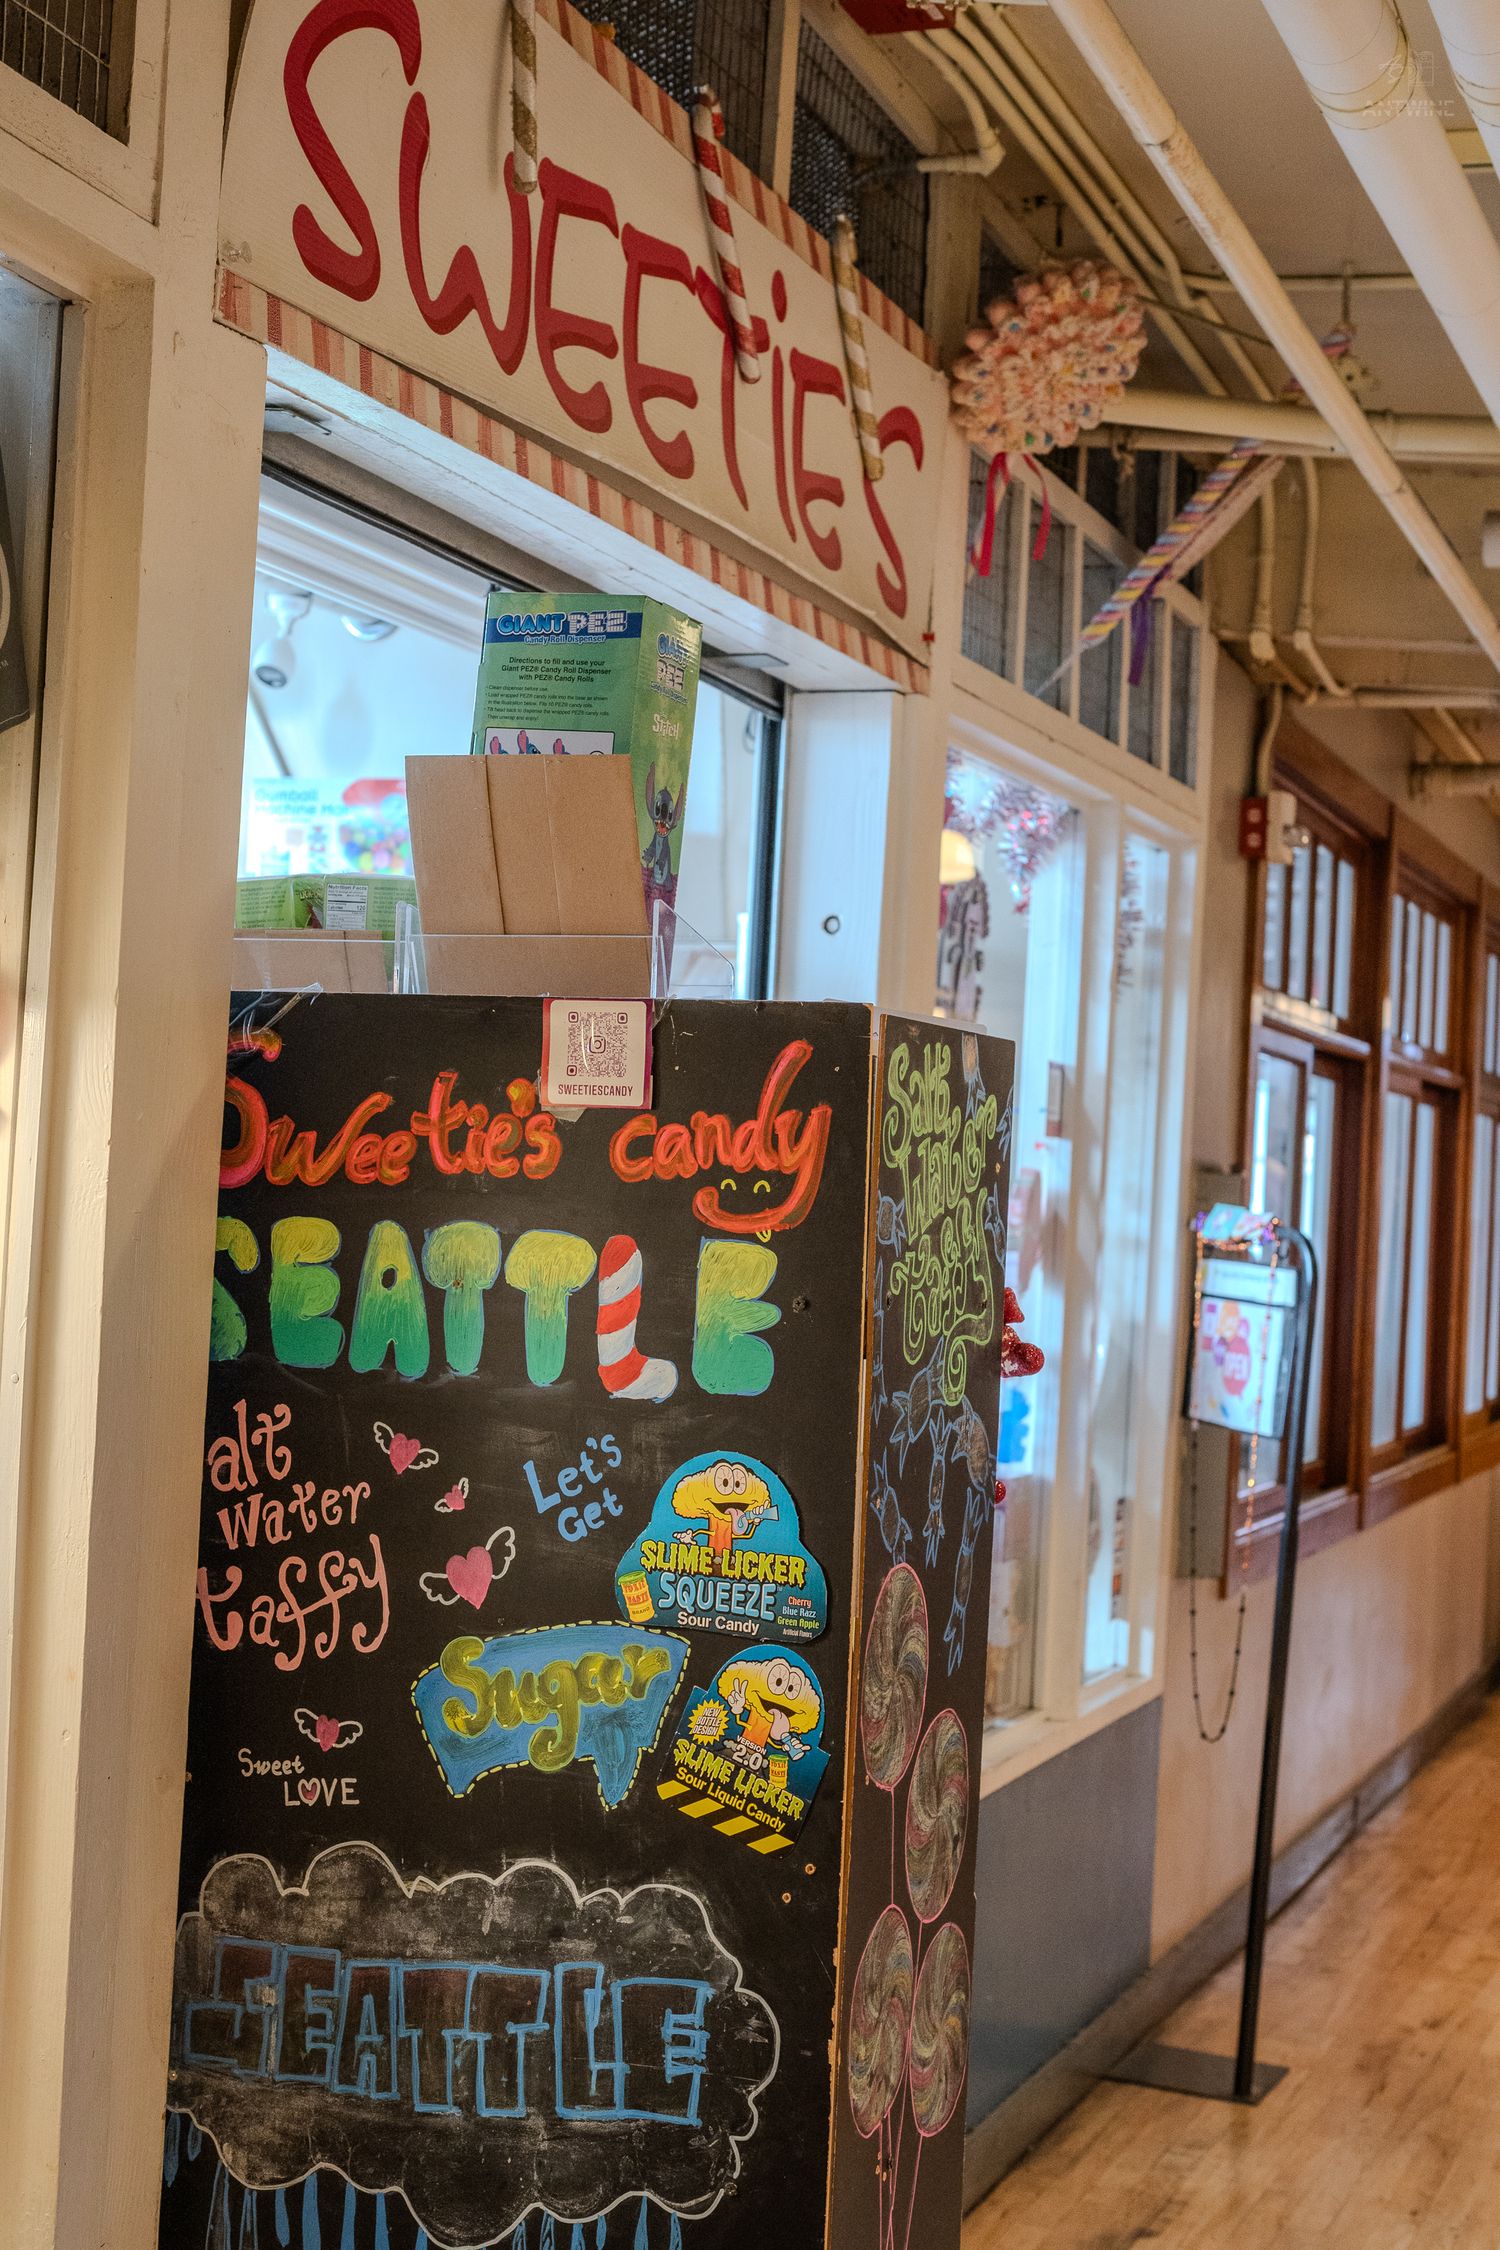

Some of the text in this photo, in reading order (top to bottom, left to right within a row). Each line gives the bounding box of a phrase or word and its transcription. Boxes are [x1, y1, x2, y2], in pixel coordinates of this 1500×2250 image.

[497, 610, 627, 635] GIANT PEZ
[524, 634, 606, 645] Candy Roll Dispenser
[509, 656, 543, 664] Directions
[590, 660, 606, 668] your
[541, 666, 561, 674] Candy
[578, 667, 611, 675] Dispenser
[554, 674, 576, 683] Candy
[656, 660, 684, 691] PEZ
[558, 1084, 634, 1097] SWEETIESCANDY
[609, 1040, 832, 1233] candy
[523, 1433, 622, 1514] Let's
[557, 1487, 624, 1542] Get
[640, 1540, 805, 1588] SLIME LICKER
[658, 1571, 777, 1621] SQUEEZE
[788, 1596, 812, 1608] Cherry
[677, 1612, 760, 1635] Sour Candy
[777, 1616, 820, 1629] Green Apple
[782, 1606, 817, 1618] Blue Razz
[440, 1636, 672, 1772] Sugar
[703, 1707, 721, 1717] NEW
[692, 1725, 719, 1736] DESIGN
[696, 1716, 721, 1727] BOTTLE
[736, 1734, 767, 1755] VERSION
[238, 1748, 305, 1776] Sweet
[732, 1743, 763, 1770] 2.0
[673, 1739, 804, 1821] SLIME LICKER
[676, 1766, 786, 1833] Sour Liquid Candy
